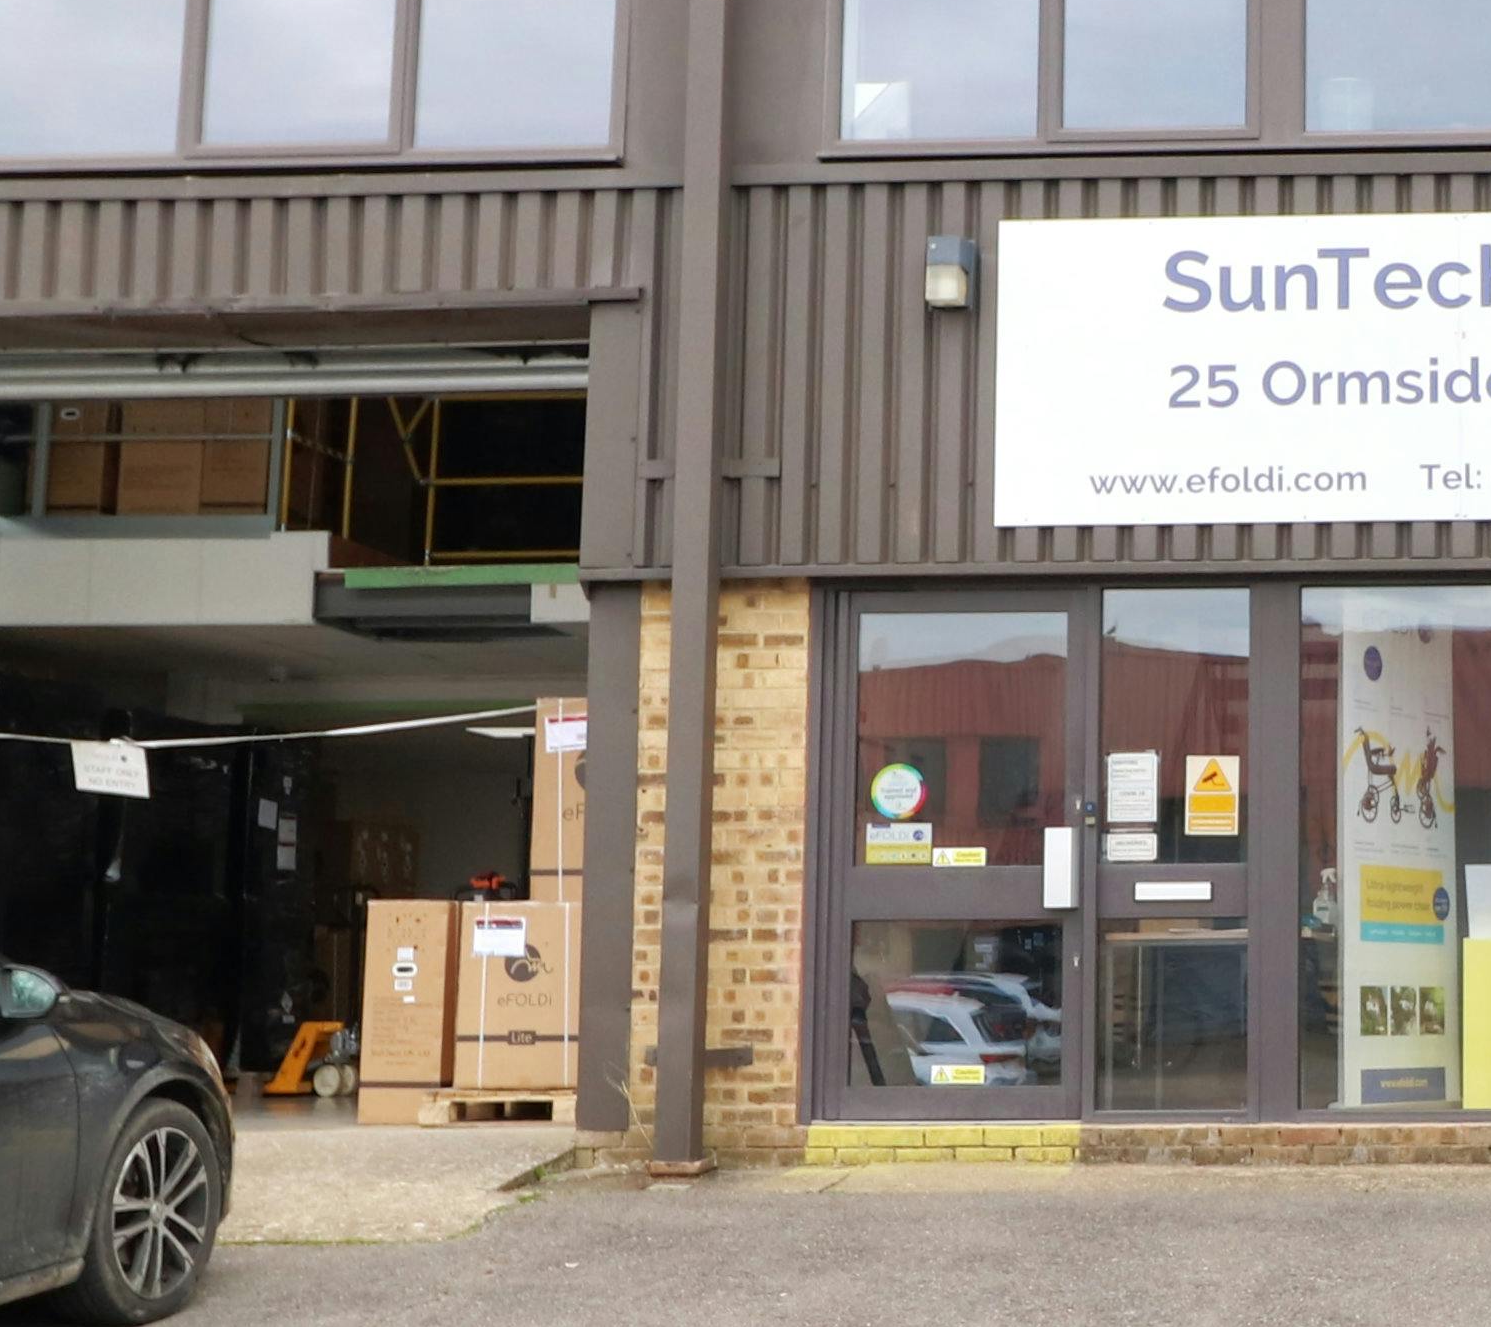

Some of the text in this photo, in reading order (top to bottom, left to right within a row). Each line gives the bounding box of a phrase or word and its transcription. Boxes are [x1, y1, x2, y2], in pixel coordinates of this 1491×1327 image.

[1168, 363, 1240, 409] 25
[1089, 465, 1367, 495] www.efoldi.com
[1418, 462, 1482, 491] Tel:
[497, 992, 553, 1007] eFOLDi
[511, 1031, 533, 1044] Lite
